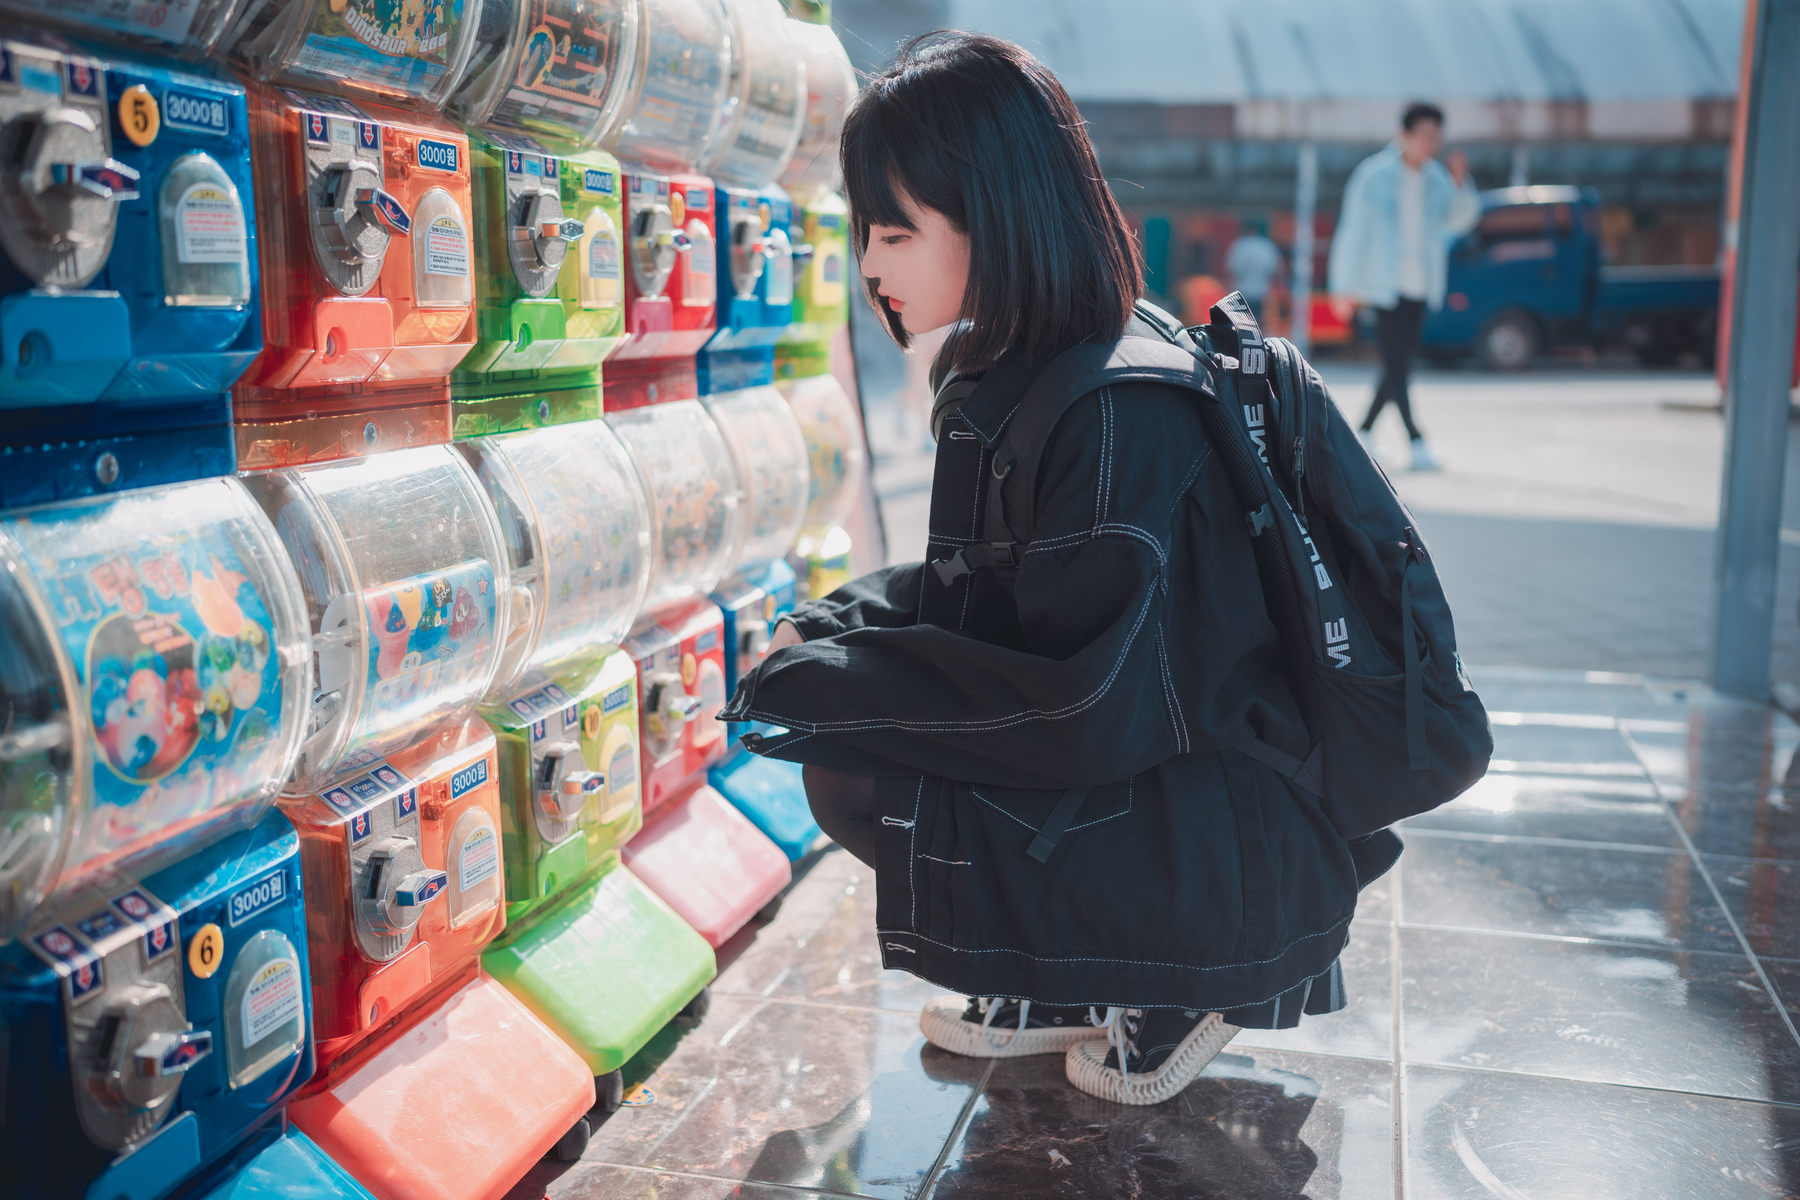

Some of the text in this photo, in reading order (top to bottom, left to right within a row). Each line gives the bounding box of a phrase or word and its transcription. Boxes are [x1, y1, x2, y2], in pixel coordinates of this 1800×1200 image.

[134, 98, 148, 133] 5
[168, 95, 225, 127] 3000원
[420, 144, 456, 167] 3000원
[453, 761, 486, 793] 3000원
[234, 875, 282, 916] 3000원
[201, 935, 214, 965] 6
